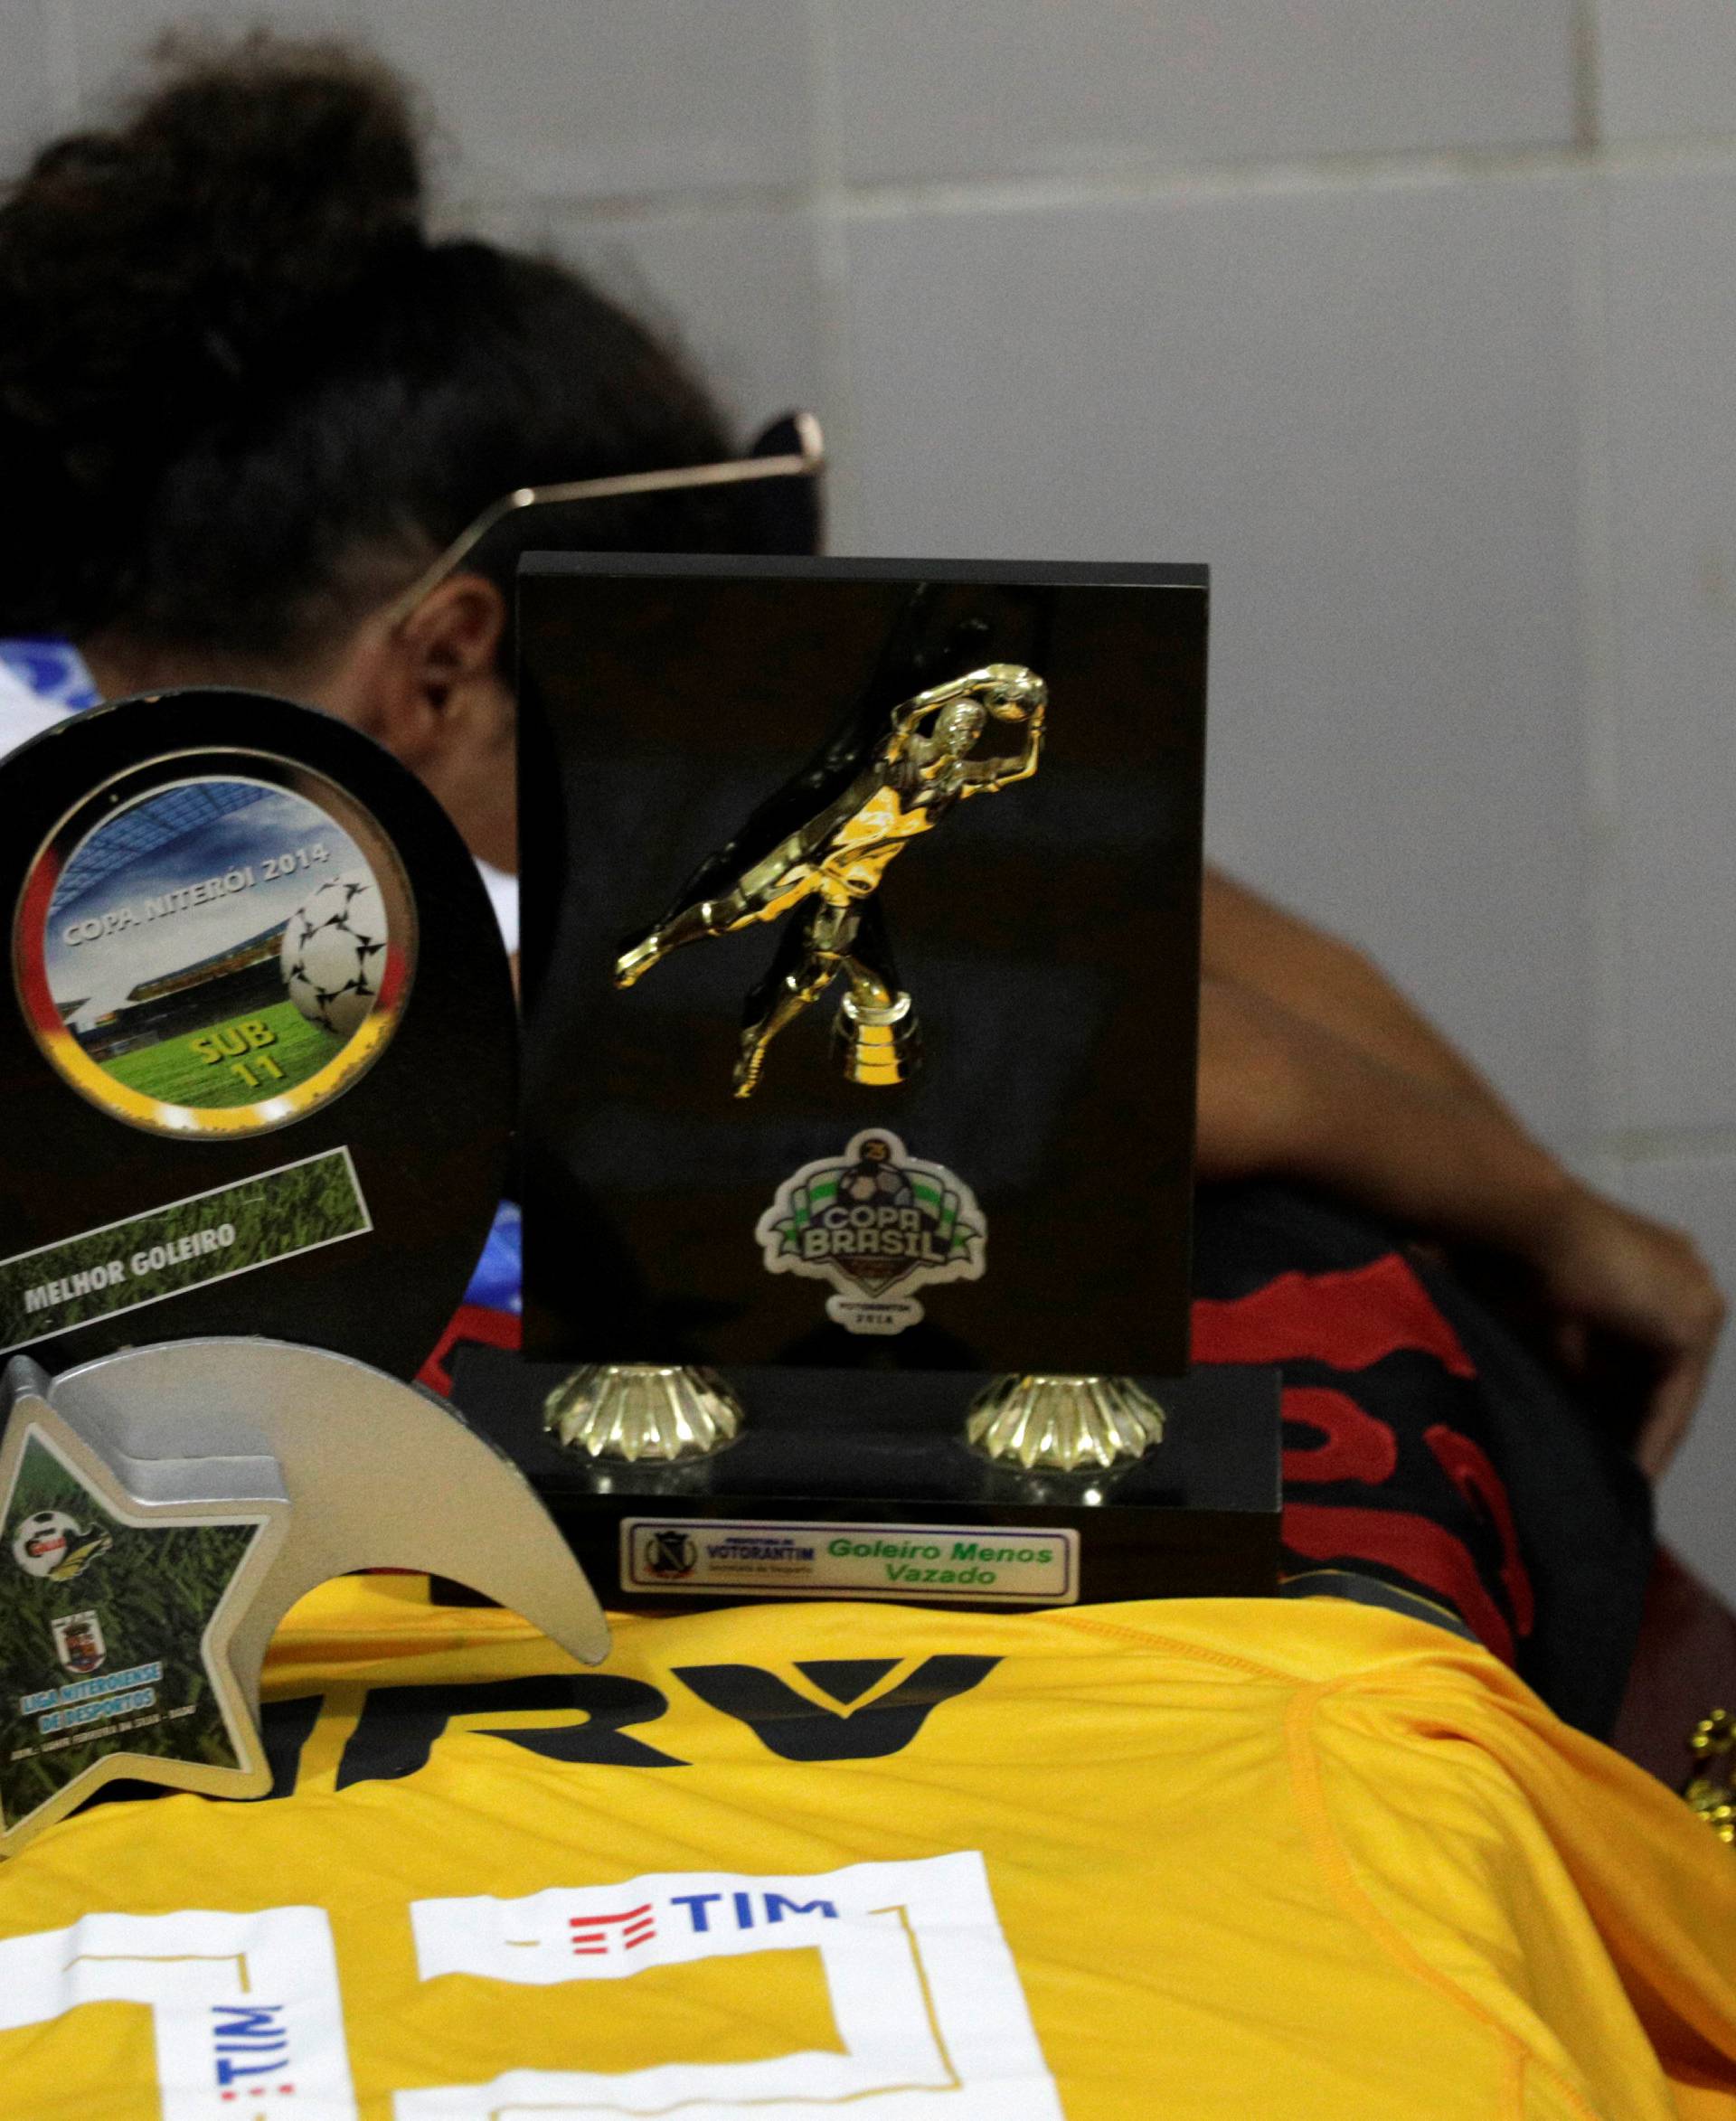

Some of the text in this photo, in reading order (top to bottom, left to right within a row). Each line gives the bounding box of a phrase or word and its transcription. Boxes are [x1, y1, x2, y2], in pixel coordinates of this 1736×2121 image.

[62, 843, 331, 947] COPA NITERÓI 2014
[189, 1020, 278, 1065] SUB
[231, 1054, 287, 1087] 11
[824, 1205, 921, 1232] COPA
[804, 1228, 947, 1262] BRASIL
[24, 1223, 237, 1313] MELHOR GOLEIRO
[707, 1545, 816, 1561] VOTORANTIM
[827, 1539, 1053, 1564] Goleiro Menos
[884, 1562, 998, 1586] Vazado
[21, 1689, 59, 1715] LIGA
[669, 1892, 840, 1934] TIM
[211, 2003, 291, 2087] TIM
